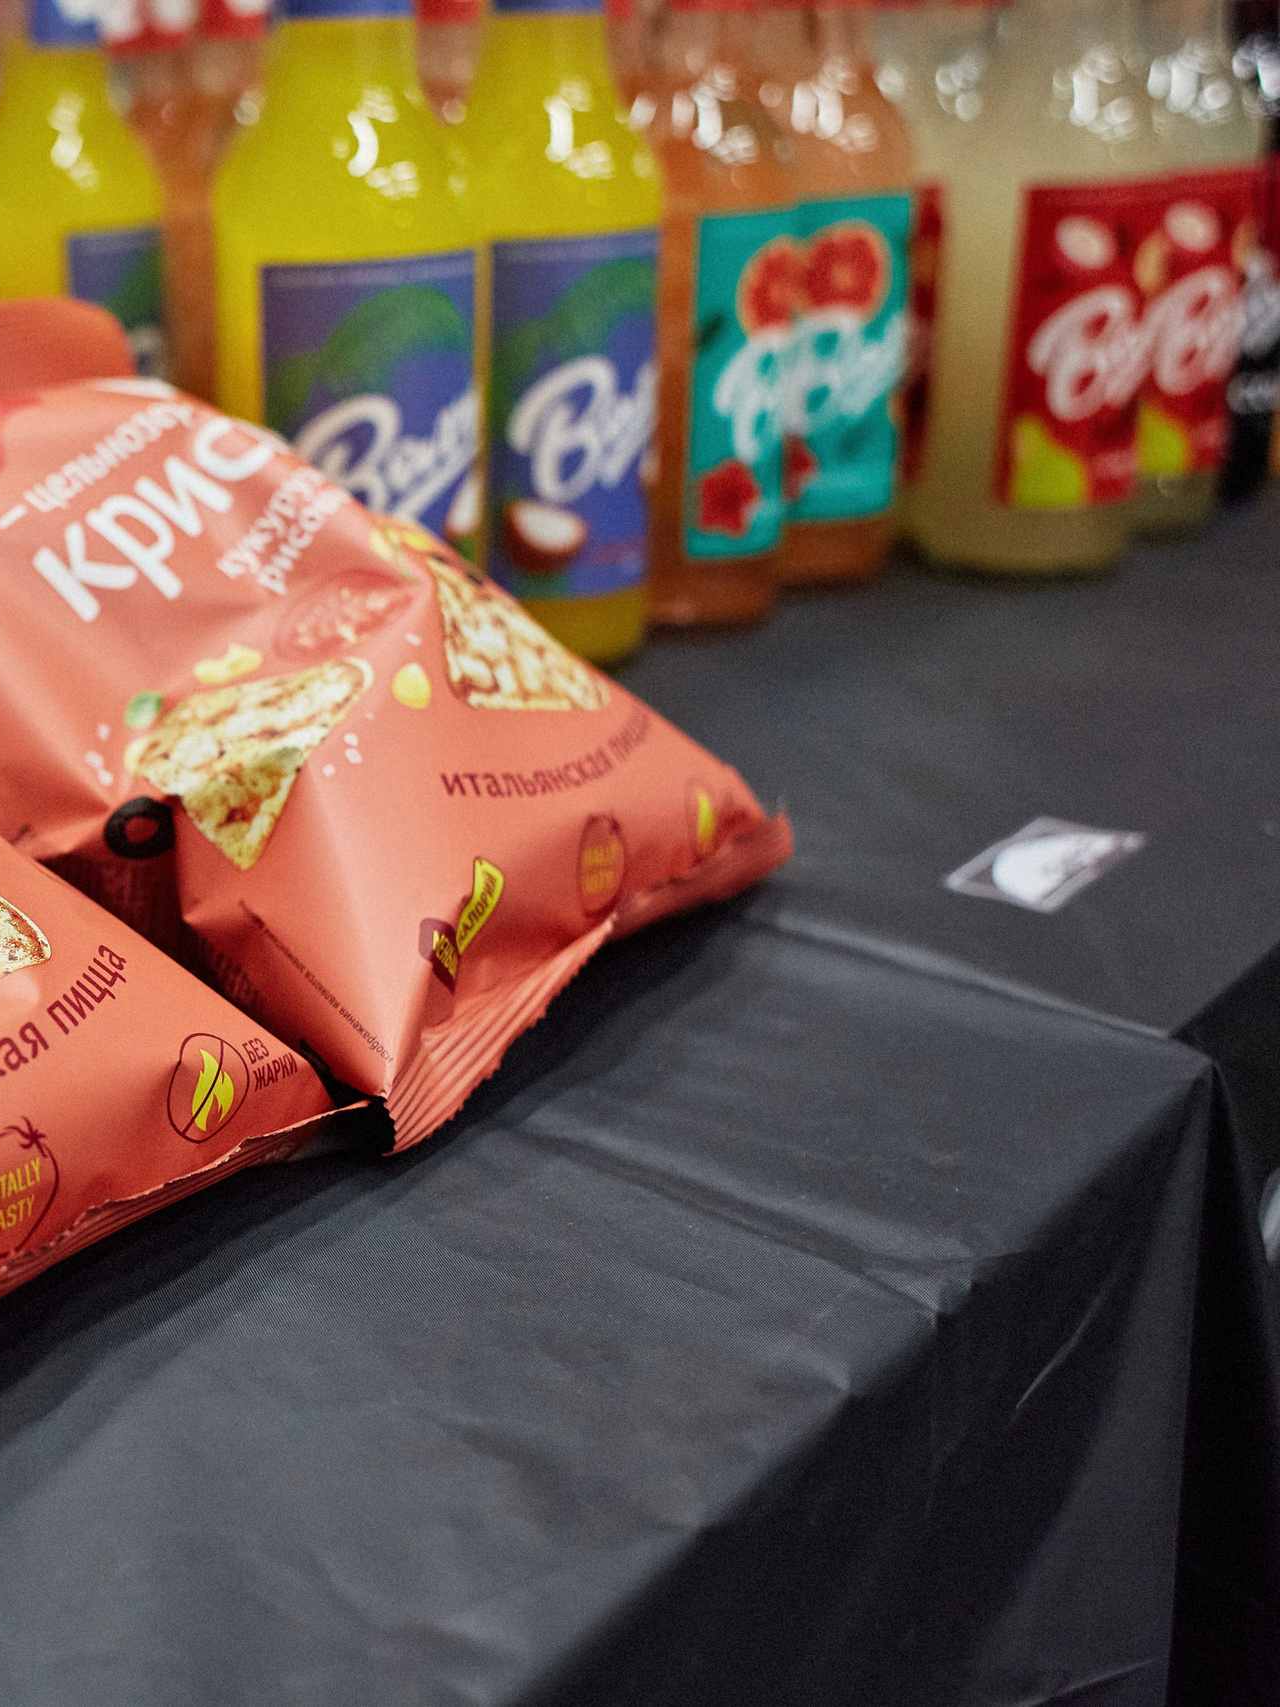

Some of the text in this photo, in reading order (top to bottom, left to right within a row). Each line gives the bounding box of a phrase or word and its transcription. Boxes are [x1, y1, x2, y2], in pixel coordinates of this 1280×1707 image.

[32, 416, 276, 622] крис
[46, 943, 128, 1037] пицца
[241, 1037, 270, 1065] БЕЗ
[252, 1051, 299, 1092] ЖАРКИ
